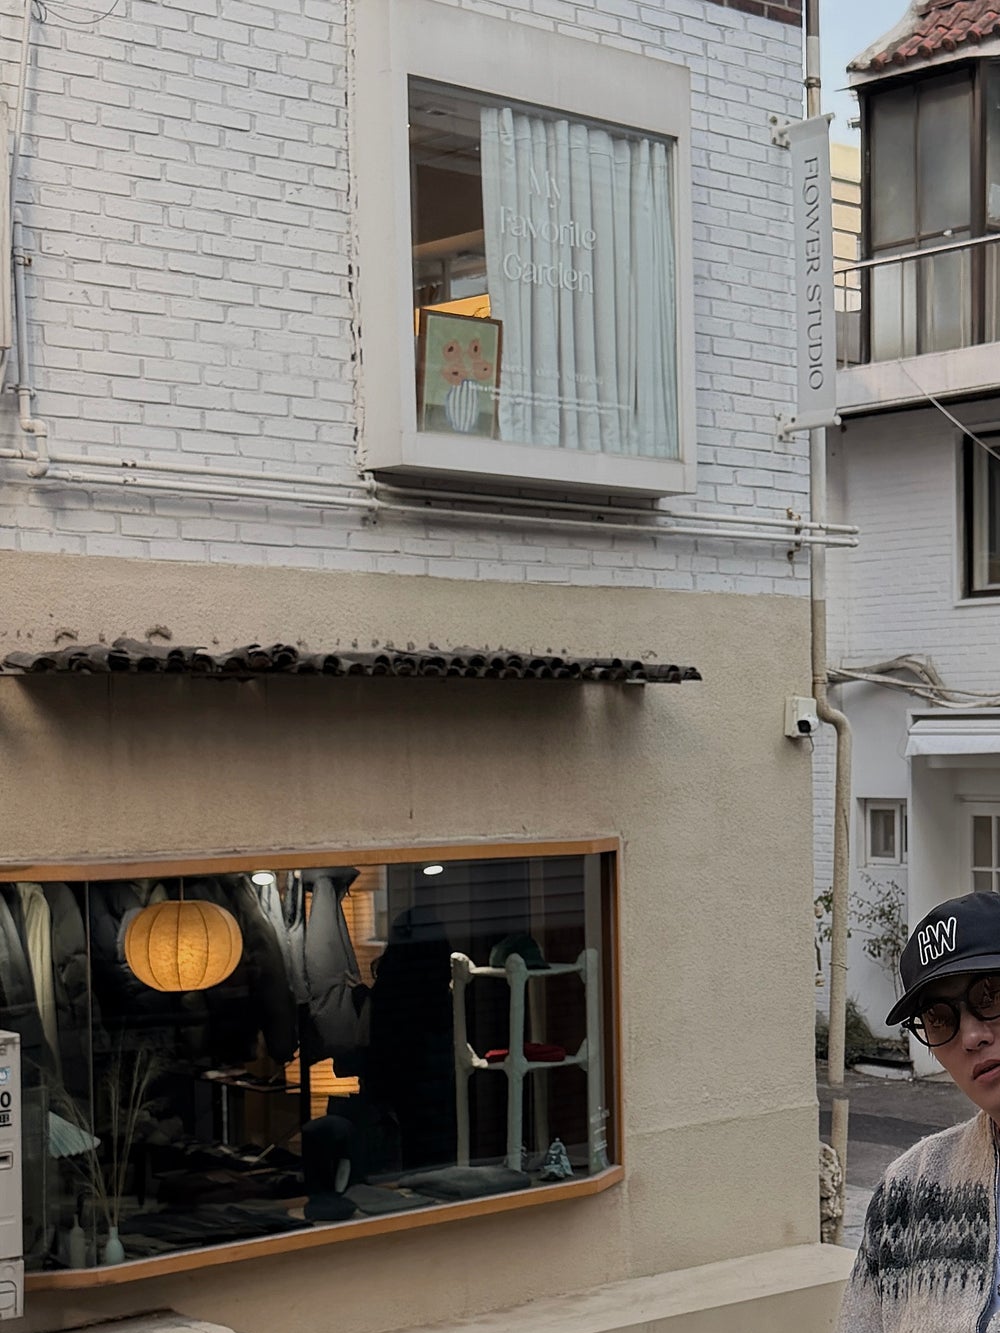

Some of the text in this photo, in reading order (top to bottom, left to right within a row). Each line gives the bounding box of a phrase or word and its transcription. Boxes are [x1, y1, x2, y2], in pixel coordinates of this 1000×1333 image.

[500, 206, 597, 251] Favorite
[503, 252, 594, 294] Garden
[803, 157, 825, 391] FLOWER STUDIO
[917, 916, 957, 966] HW
